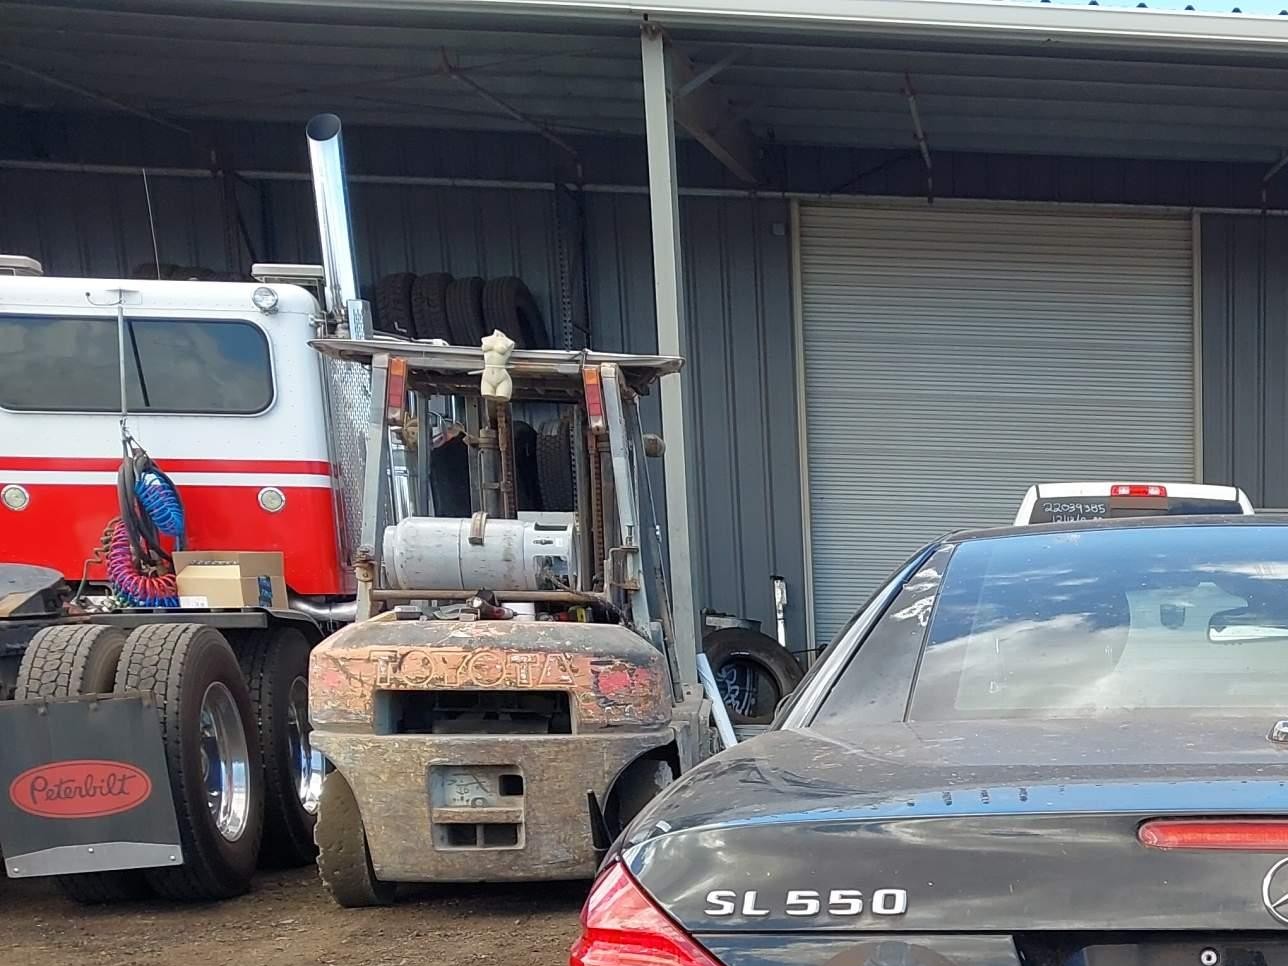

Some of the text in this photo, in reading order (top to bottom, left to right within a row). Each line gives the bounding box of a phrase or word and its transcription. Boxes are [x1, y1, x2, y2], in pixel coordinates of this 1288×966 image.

[369, 650, 577, 687] TOYOTA
[30, 773, 136, 805] Peterbilt
[704, 889, 907, 915] SL 550
